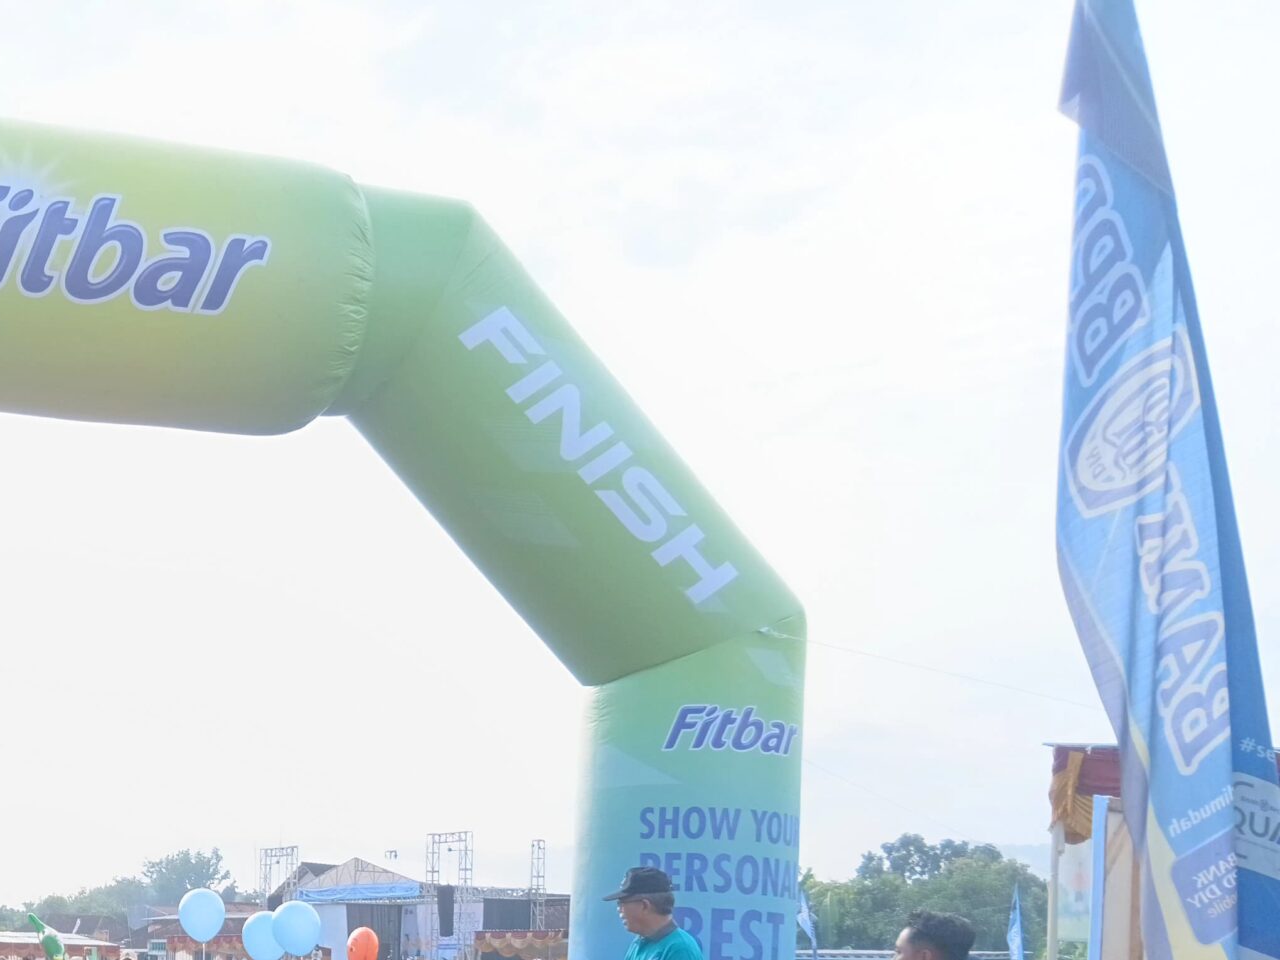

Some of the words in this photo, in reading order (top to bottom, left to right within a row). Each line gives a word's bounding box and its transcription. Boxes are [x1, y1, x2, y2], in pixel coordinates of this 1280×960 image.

[458, 305, 739, 604] FINISH
[662, 704, 798, 757] Fitbar
[639, 806, 741, 841] SHOW
